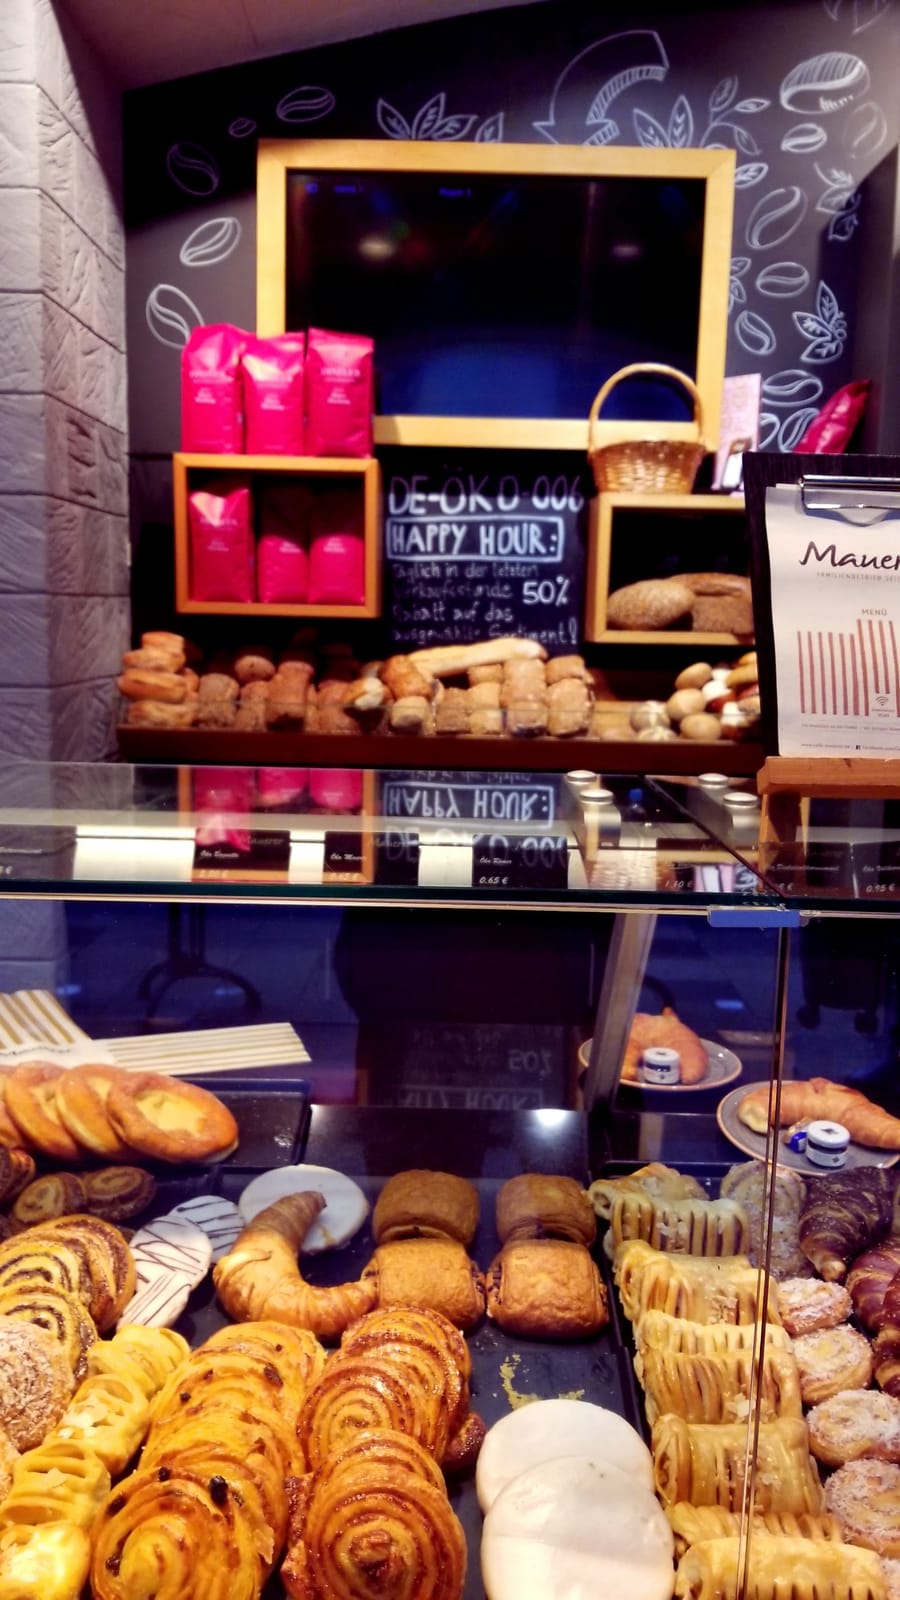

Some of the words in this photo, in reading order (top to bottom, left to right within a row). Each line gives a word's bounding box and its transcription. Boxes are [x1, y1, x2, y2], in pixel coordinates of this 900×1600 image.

[392, 523, 467, 555] HAPPY
[480, 522, 559, 555] HOUR:
[445, 563, 459, 577] in
[465, 562, 486, 578] der
[522, 576, 571, 606] 50%
[453, 602, 480, 622] auf
[485, 603, 515, 622] das
[861, 607, 888, 617] MENÜ
[479, 876, 499, 884] 0.65
[502, 876, 509, 885] €
